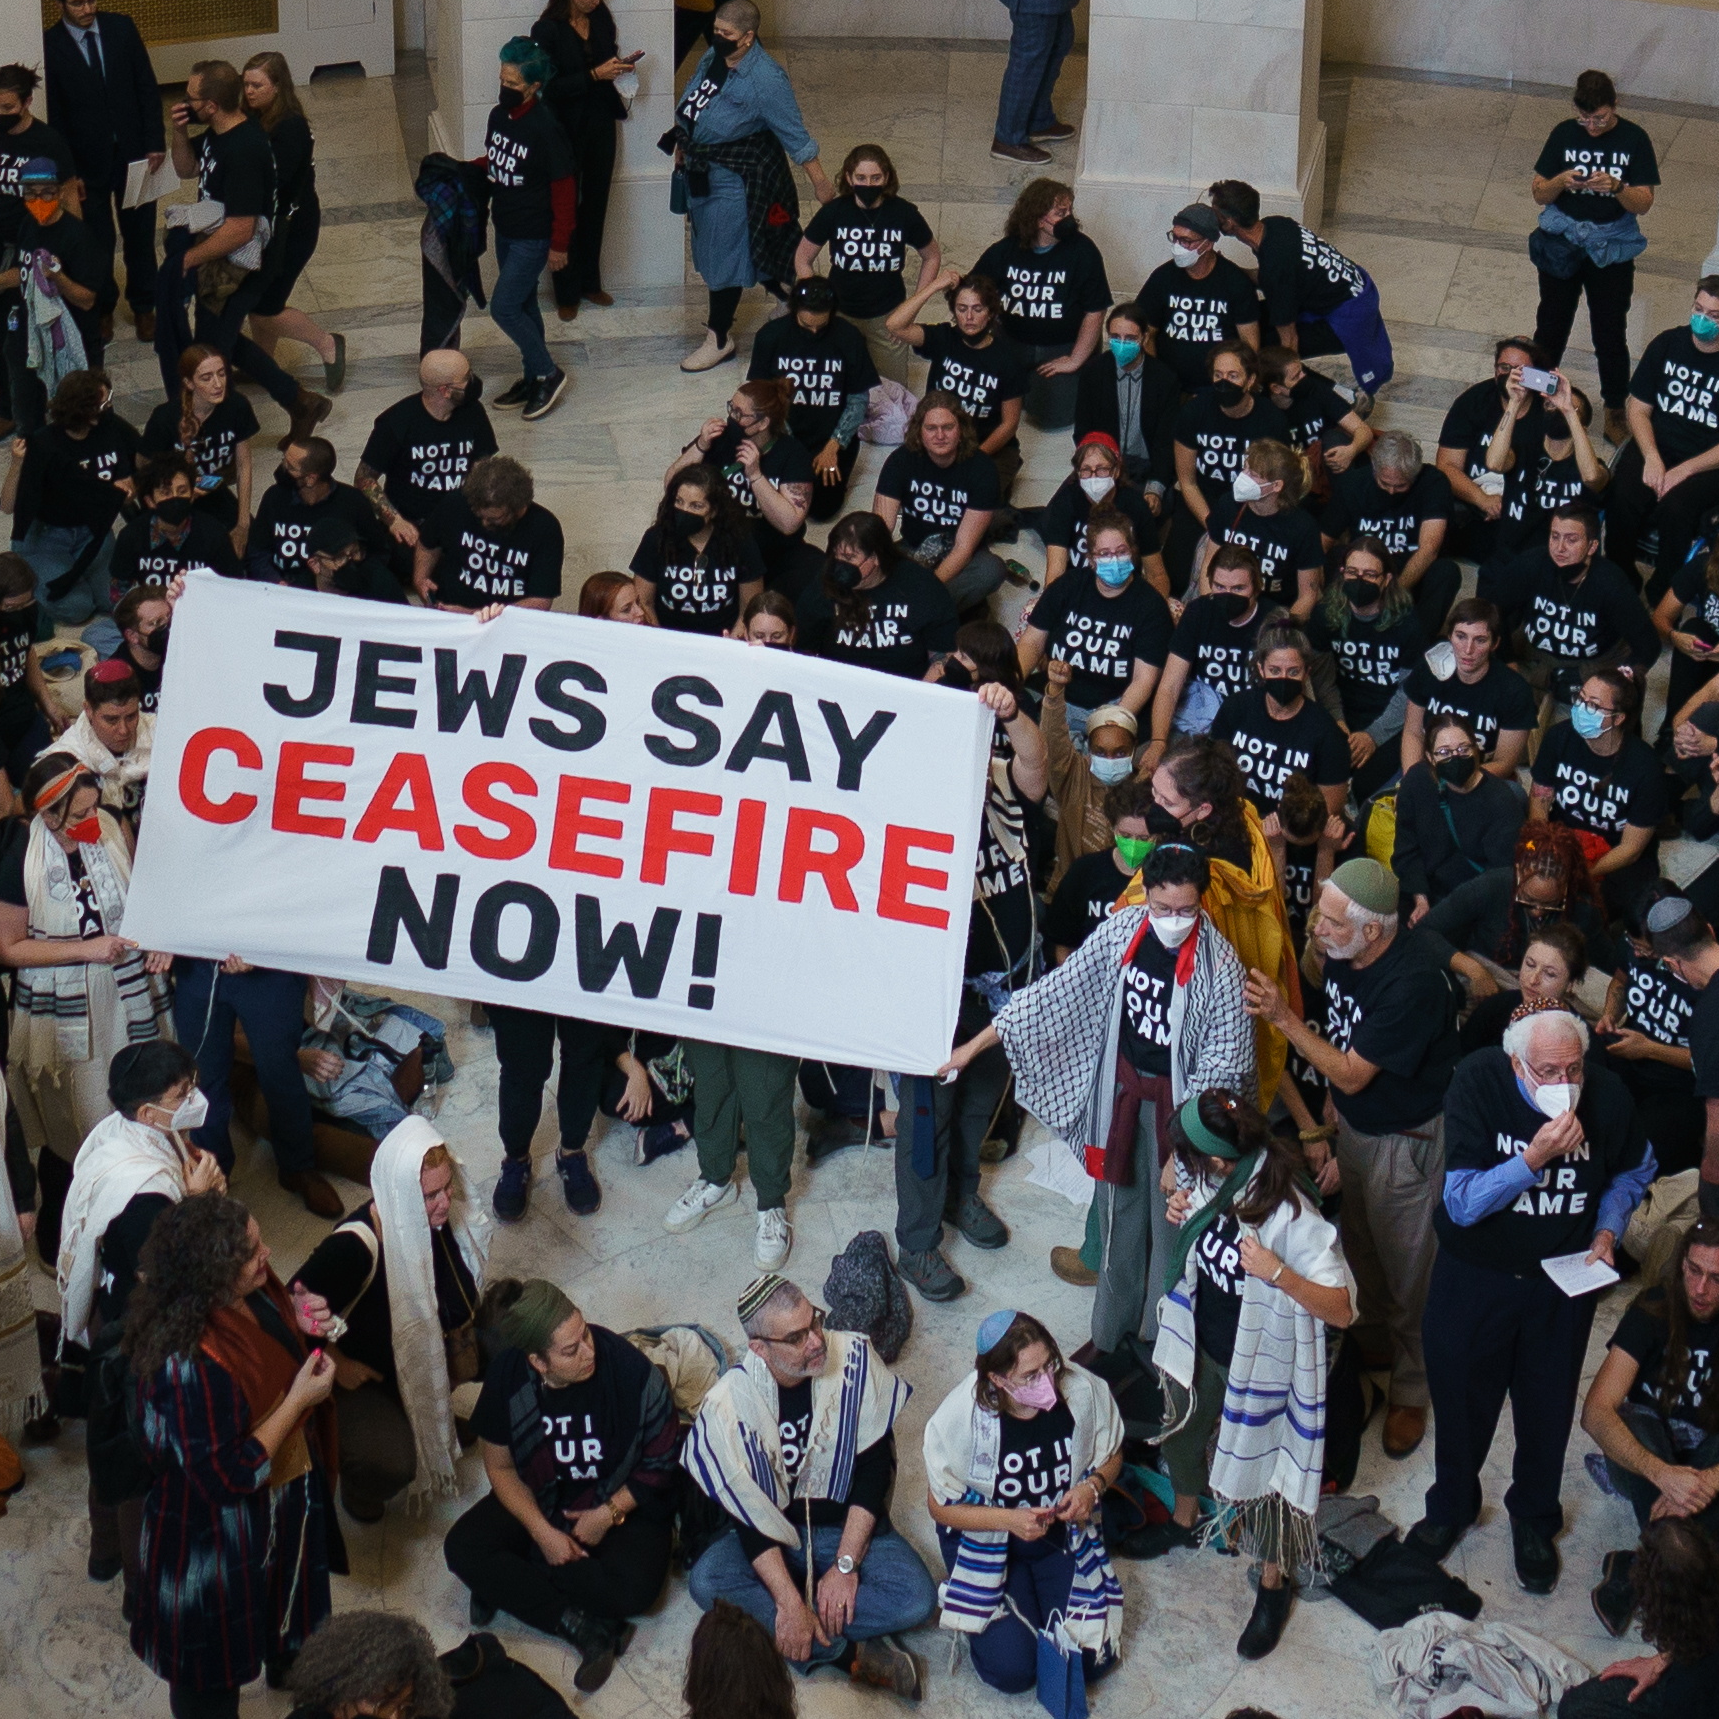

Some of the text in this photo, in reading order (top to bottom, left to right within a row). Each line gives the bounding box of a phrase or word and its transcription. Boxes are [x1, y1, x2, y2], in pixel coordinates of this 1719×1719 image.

[512, 141, 528, 159] IN
[1565, 149, 1631, 165] NOT IN
[837, 227, 902, 241] NOT IN
[843, 240, 891, 258] OUR
[835, 253, 901, 272] NAME
[1007, 266, 1066, 283] NOT IN
[1011, 281, 1055, 301] OUR
[1169, 296, 1227, 314] NOT IN
[1173, 311, 1218, 329] OUR
[1166, 325, 1223, 342] NAME
[779, 357, 842, 372] NOT IN
[1664, 360, 1702, 383] NOT
[978, 372, 998, 389] IN
[1668, 379, 1714, 410] OUR
[1196, 434, 1232, 450] NOT
[412, 445, 453, 460] NOT
[421, 459, 469, 475] OUR
[910, 480, 968, 503] NOT IN
[914, 497, 962, 518] OUR
[1398, 517, 1414, 529] IN
[462, 533, 528, 567] NOT IN
[1267, 544, 1288, 560] IN
[139, 557, 177, 572] NOT
[467, 553, 514, 576] OUR
[715, 567, 736, 581] IN
[671, 584, 727, 601] OUR
[887, 605, 908, 618] IN
[1535, 596, 1596, 626] NOT IN
[1066, 611, 1132, 640] NOT IN
[1536, 617, 1587, 645] OUR
[1066, 631, 1120, 657] OUR
[1198, 646, 1237, 659] NOT
[1380, 646, 1399, 659] IN
[1052, 645, 1128, 678] NAME
[263, 629, 897, 791] JEWS SAY
[1477, 715, 1497, 730] IN
[1233, 731, 1309, 768] NOT IN
[1557, 762, 1629, 804] NOT IN
[1563, 785, 1618, 819] OUR
[178, 726, 955, 930] CEASEFIRE
[365, 866, 723, 1010] NOW!
[1627, 985, 1680, 1034] OUR
[1669, 995, 1692, 1017] IN
[1565, 1140, 1590, 1160] IN
